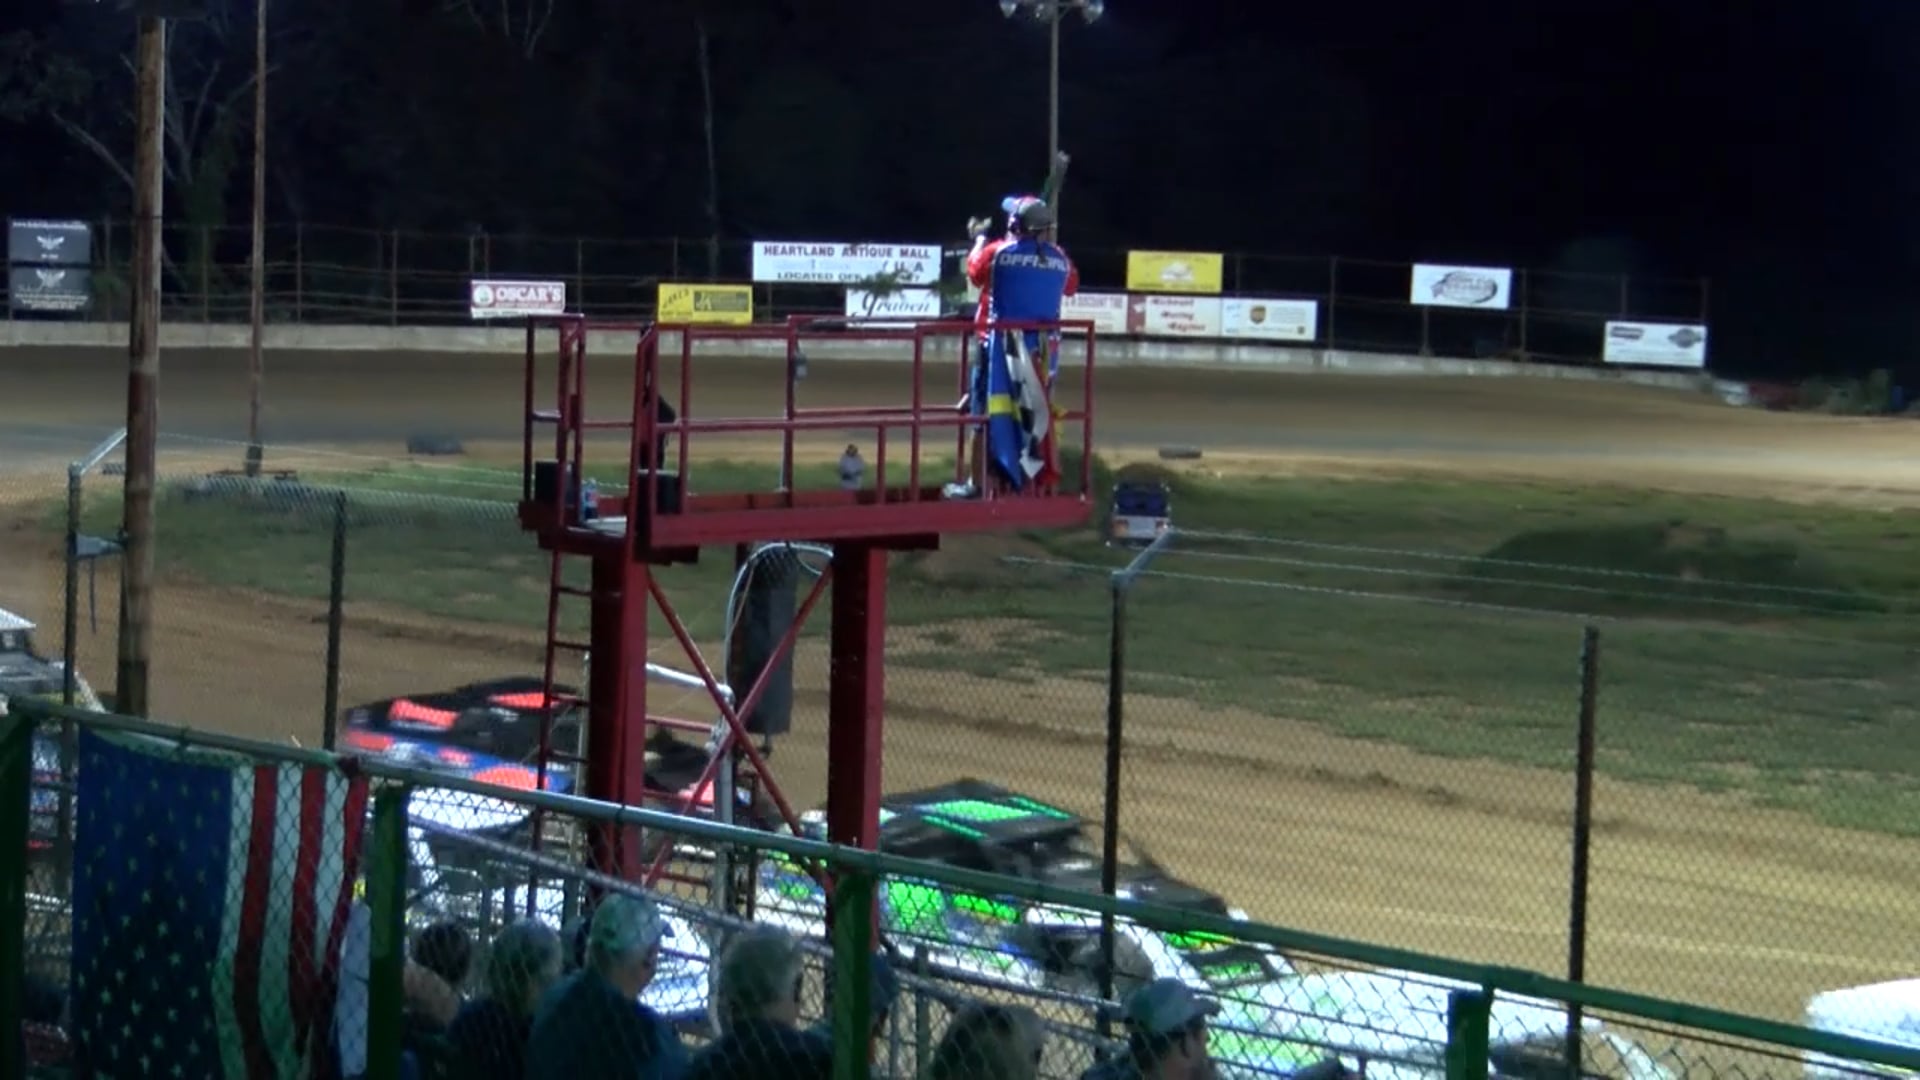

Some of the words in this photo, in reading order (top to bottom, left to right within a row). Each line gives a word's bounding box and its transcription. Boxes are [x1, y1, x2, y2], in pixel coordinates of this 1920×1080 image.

[763, 245, 835, 257] HEARTLAND
[841, 246, 893, 258] ANTIQUE
[899, 247, 931, 259] MALL
[777, 271, 834, 281] LOCATED
[496, 286, 562, 301] OSCAR'S
